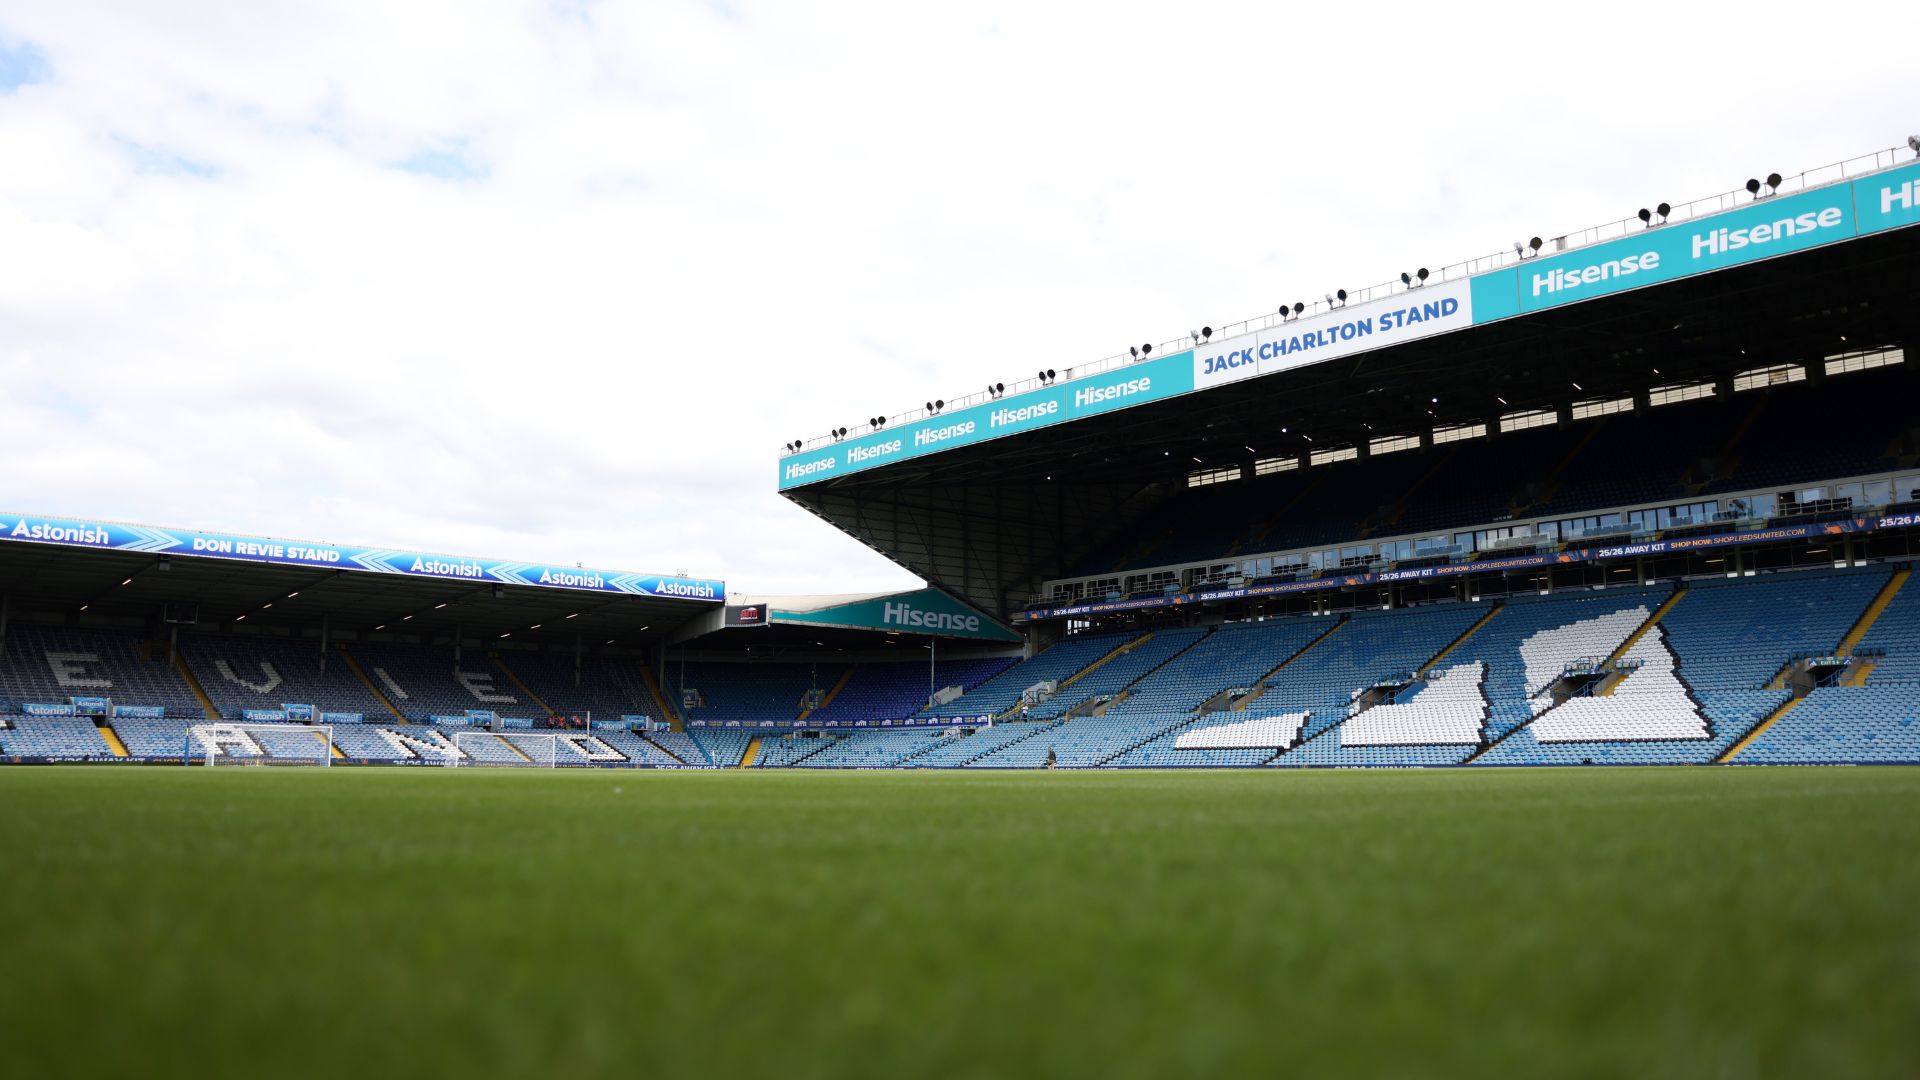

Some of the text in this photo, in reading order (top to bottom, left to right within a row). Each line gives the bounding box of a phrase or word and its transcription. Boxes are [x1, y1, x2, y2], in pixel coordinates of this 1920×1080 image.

[1692, 206, 1842, 258] Hisense
[1532, 251, 1660, 296] Hisense
[1204, 297, 1458, 374] JACK CHARLTON STAND
[1075, 376, 1150, 408] Hisense
[990, 399, 1058, 428] Hisense
[914, 419, 975, 446] Hisense
[847, 439, 901, 464] Hisense
[786, 455, 835, 480] Hisense
[11, 519, 109, 544] Astonish
[1880, 516, 1911, 527] 25/26
[193, 538, 340, 562] DON REVIE STAND
[1599, 543, 1665, 556] 25/26 AWAY KIT
[410, 556, 482, 578] Astonish
[539, 568, 604, 589] Astonish
[1380, 568, 1432, 580] 25/26 AWAY KIT
[656, 578, 714, 598] Astonish
[884, 602, 978, 632] Hisense
[27, 706, 71, 715] Astonish
[247, 712, 284, 720] Astonish
